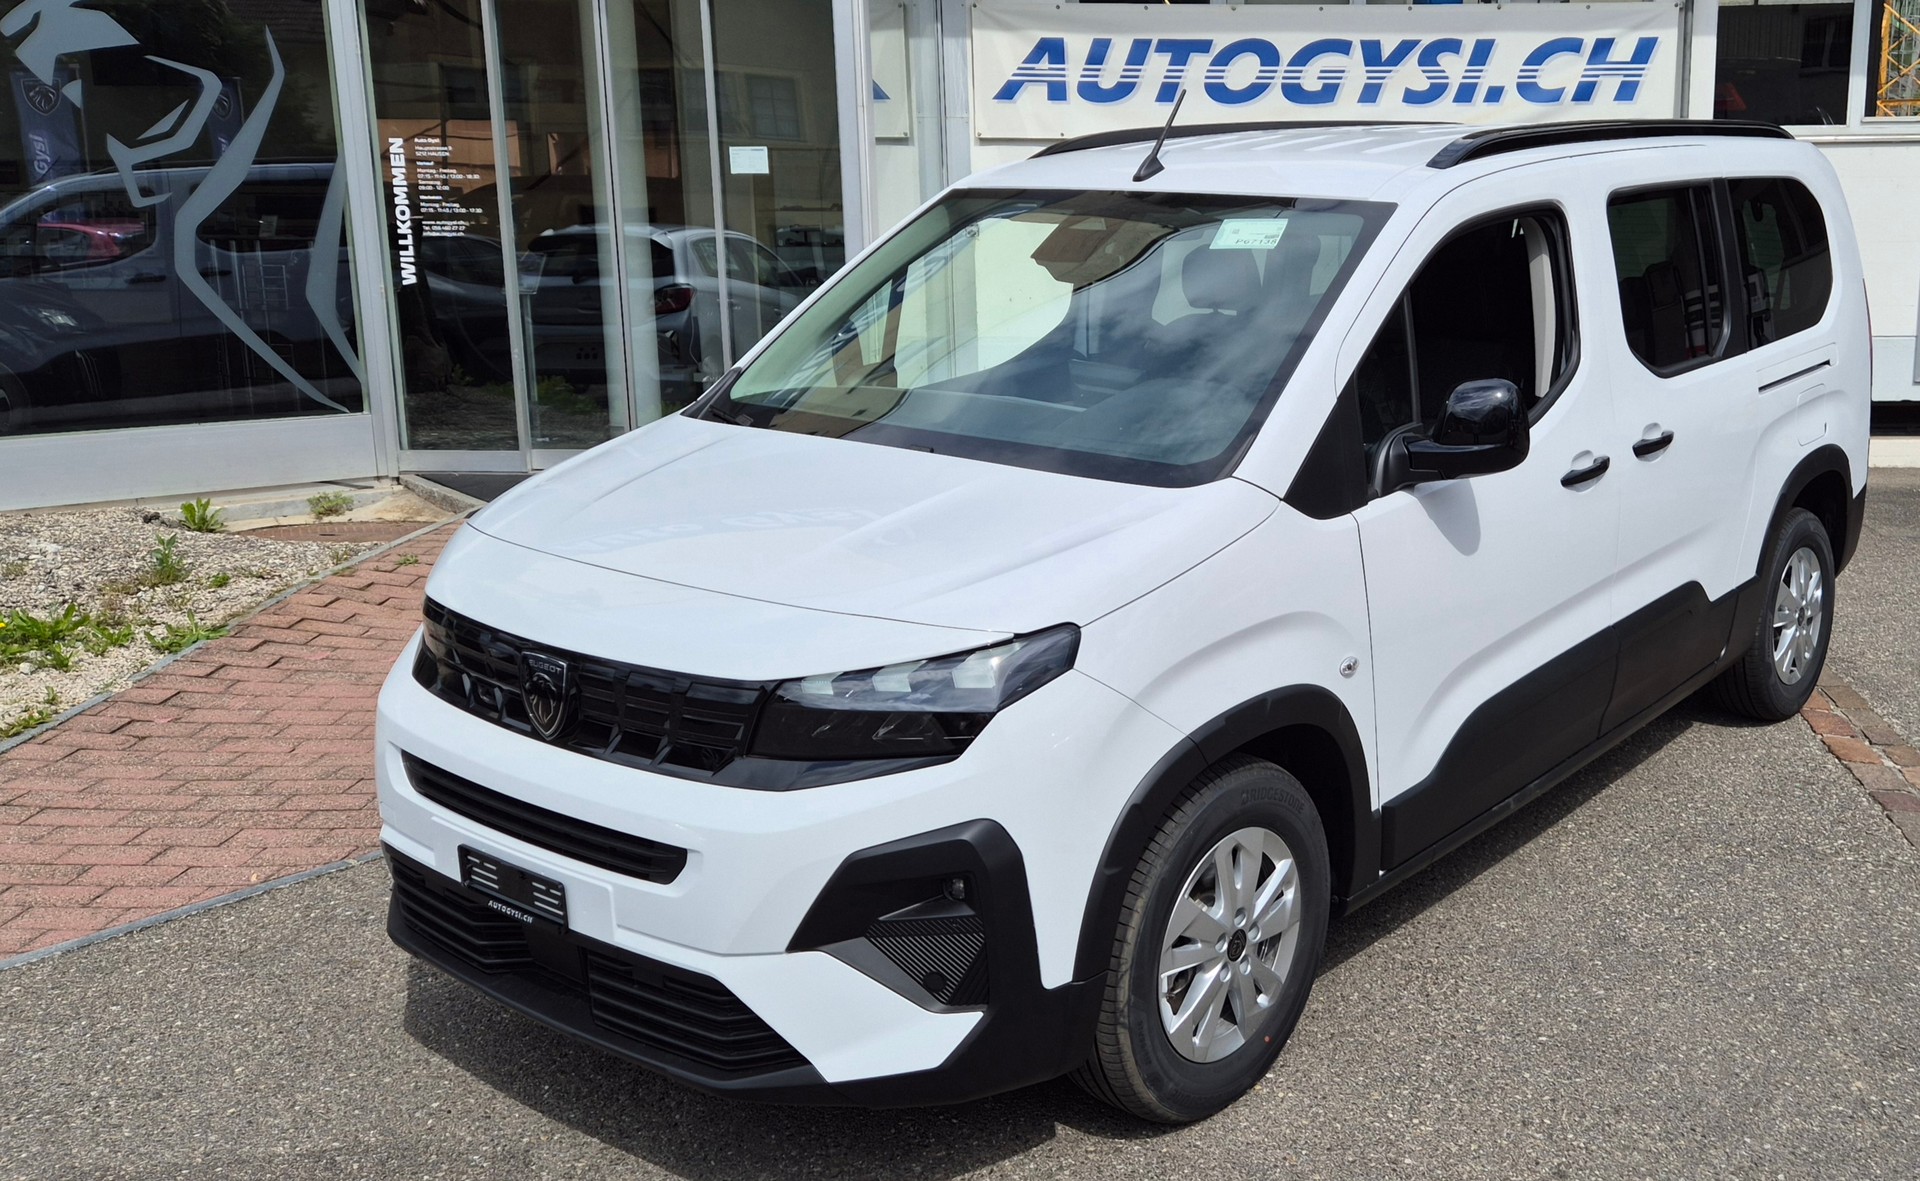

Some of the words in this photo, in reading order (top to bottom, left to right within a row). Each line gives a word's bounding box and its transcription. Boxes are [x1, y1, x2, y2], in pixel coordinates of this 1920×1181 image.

[991, 36, 1660, 106] AUTOGYSI.CH
[388, 137, 418, 286] WILLKOMMEN
[527, 659, 562, 674] EUGEOT
[487, 900, 534, 924] AUTOGYSI.CH
